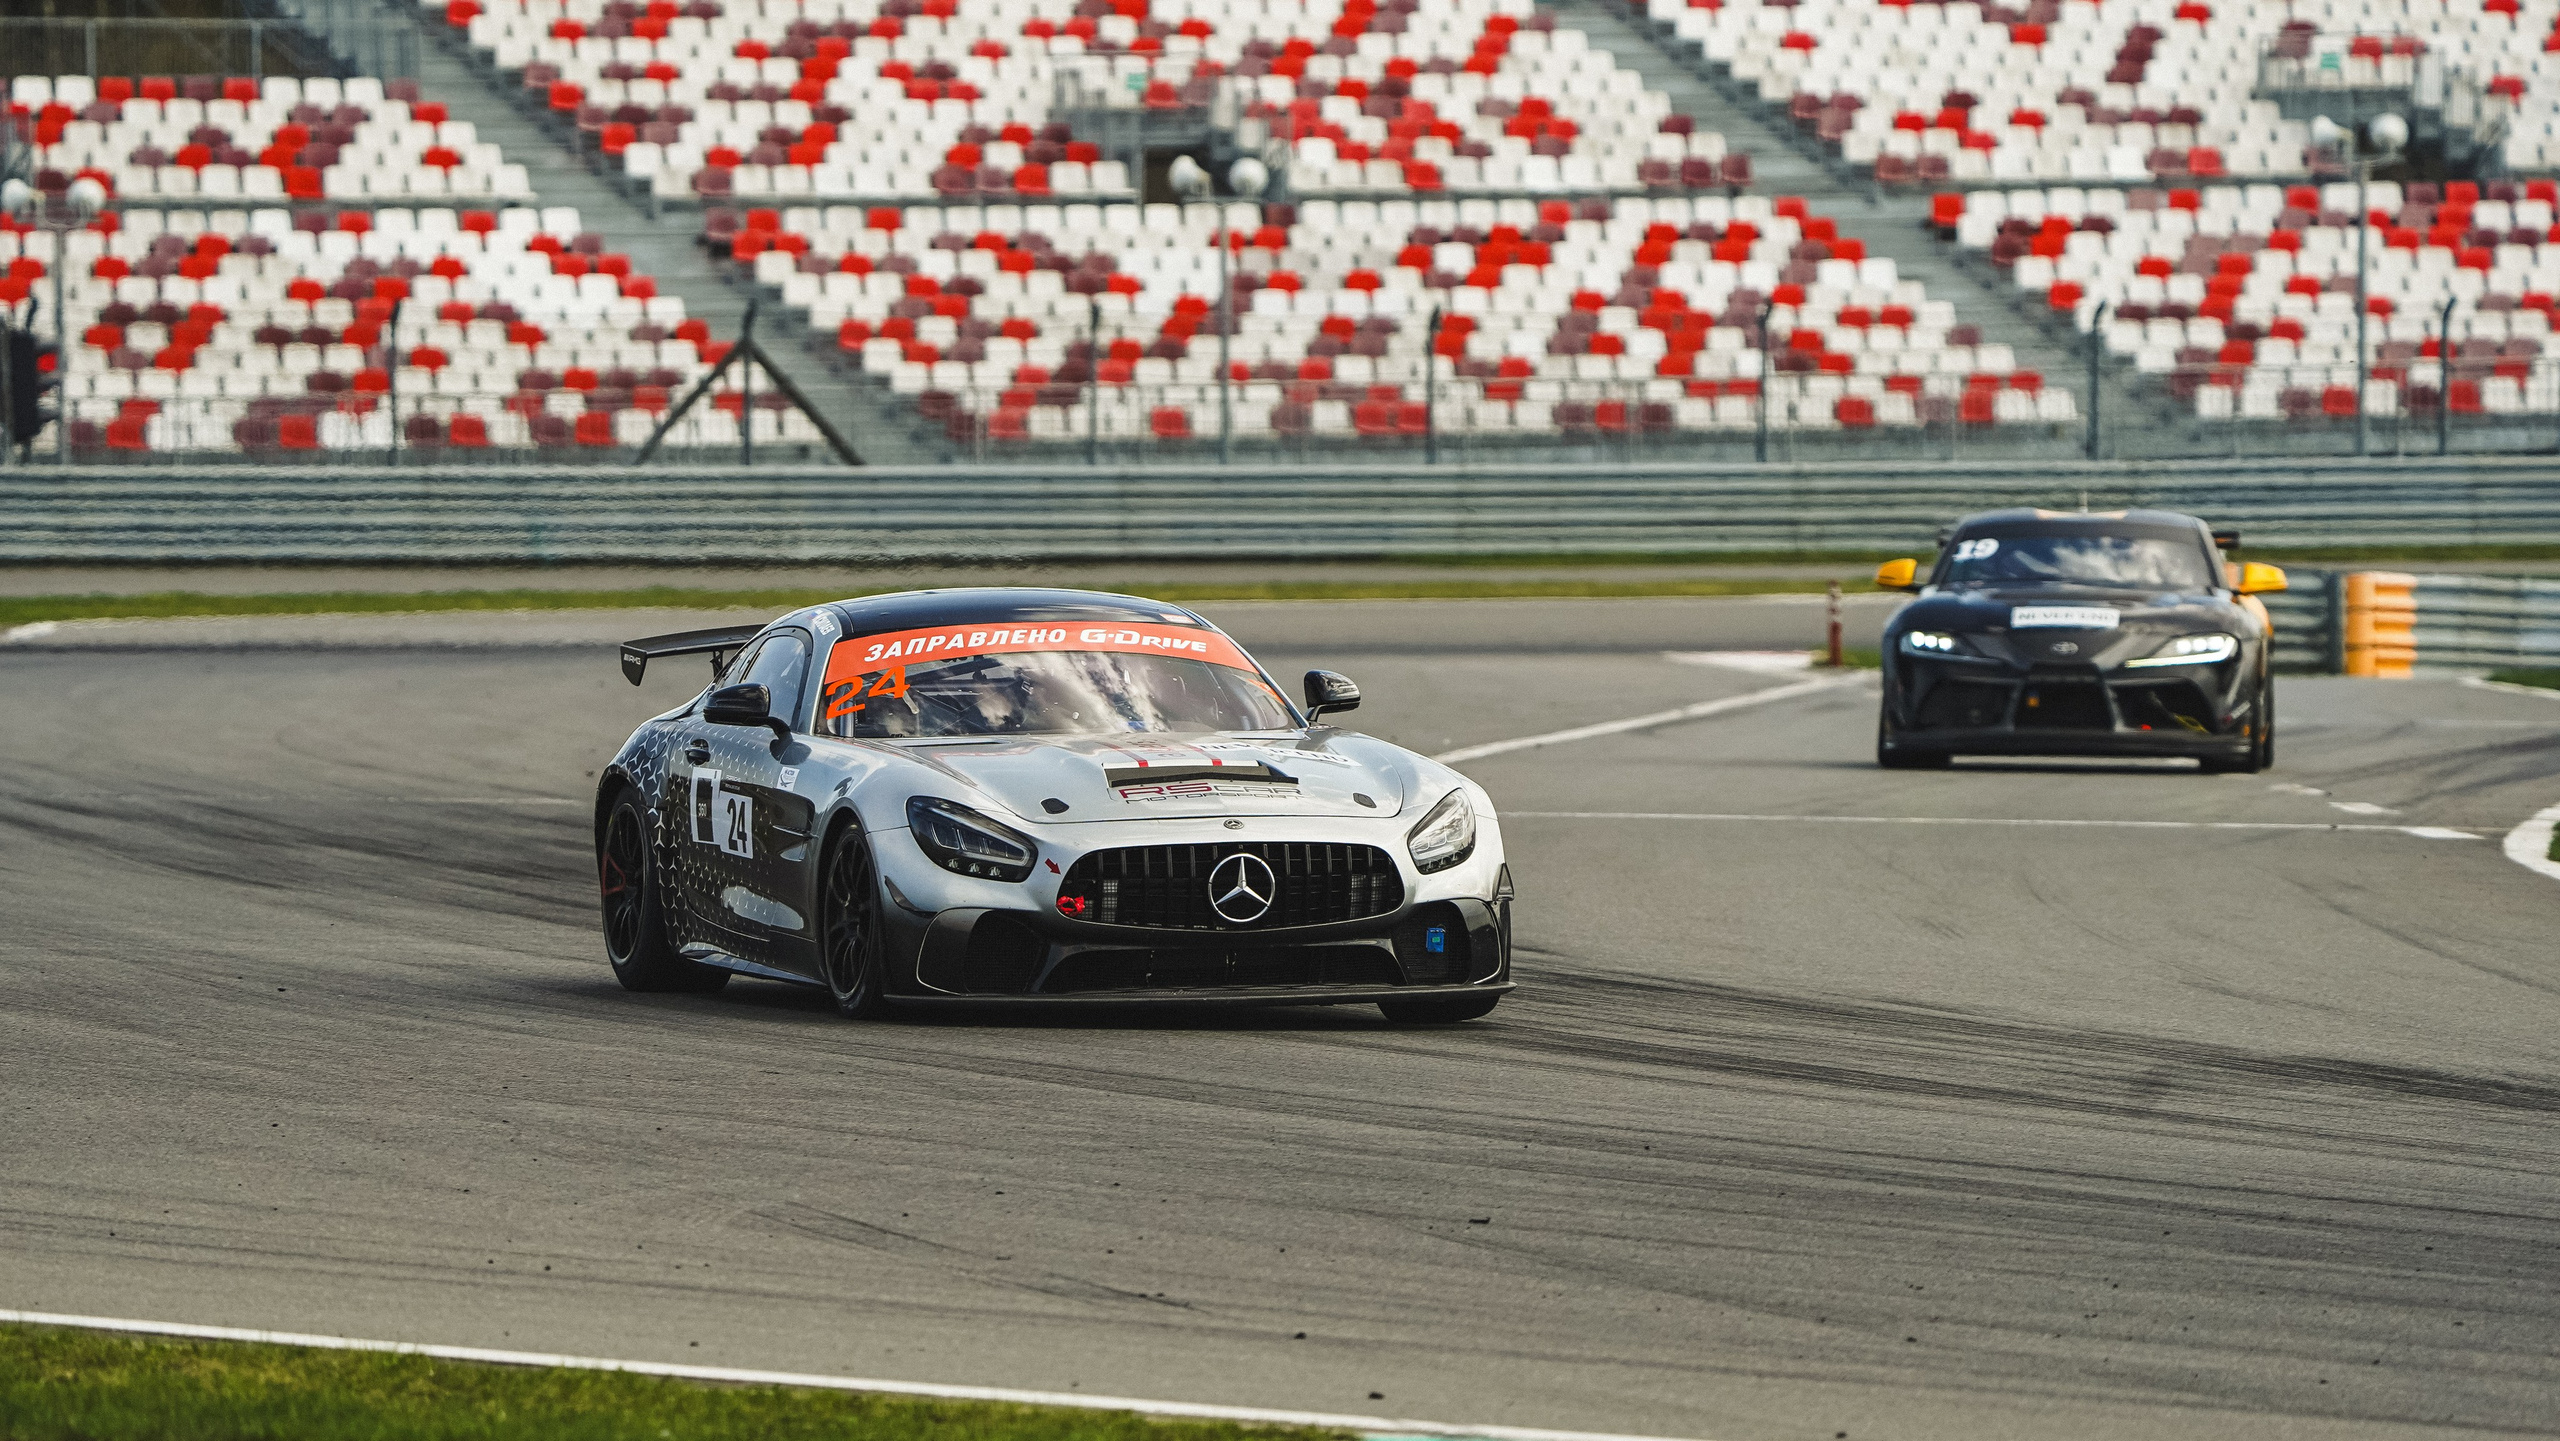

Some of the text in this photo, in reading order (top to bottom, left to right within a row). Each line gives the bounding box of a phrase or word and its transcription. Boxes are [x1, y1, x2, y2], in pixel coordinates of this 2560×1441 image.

[1952, 537, 2000, 562] 19
[864, 628, 1067, 662] ЗАПРАВЛЕНО
[825, 665, 911, 720] 24
[726, 798, 748, 854] 24
